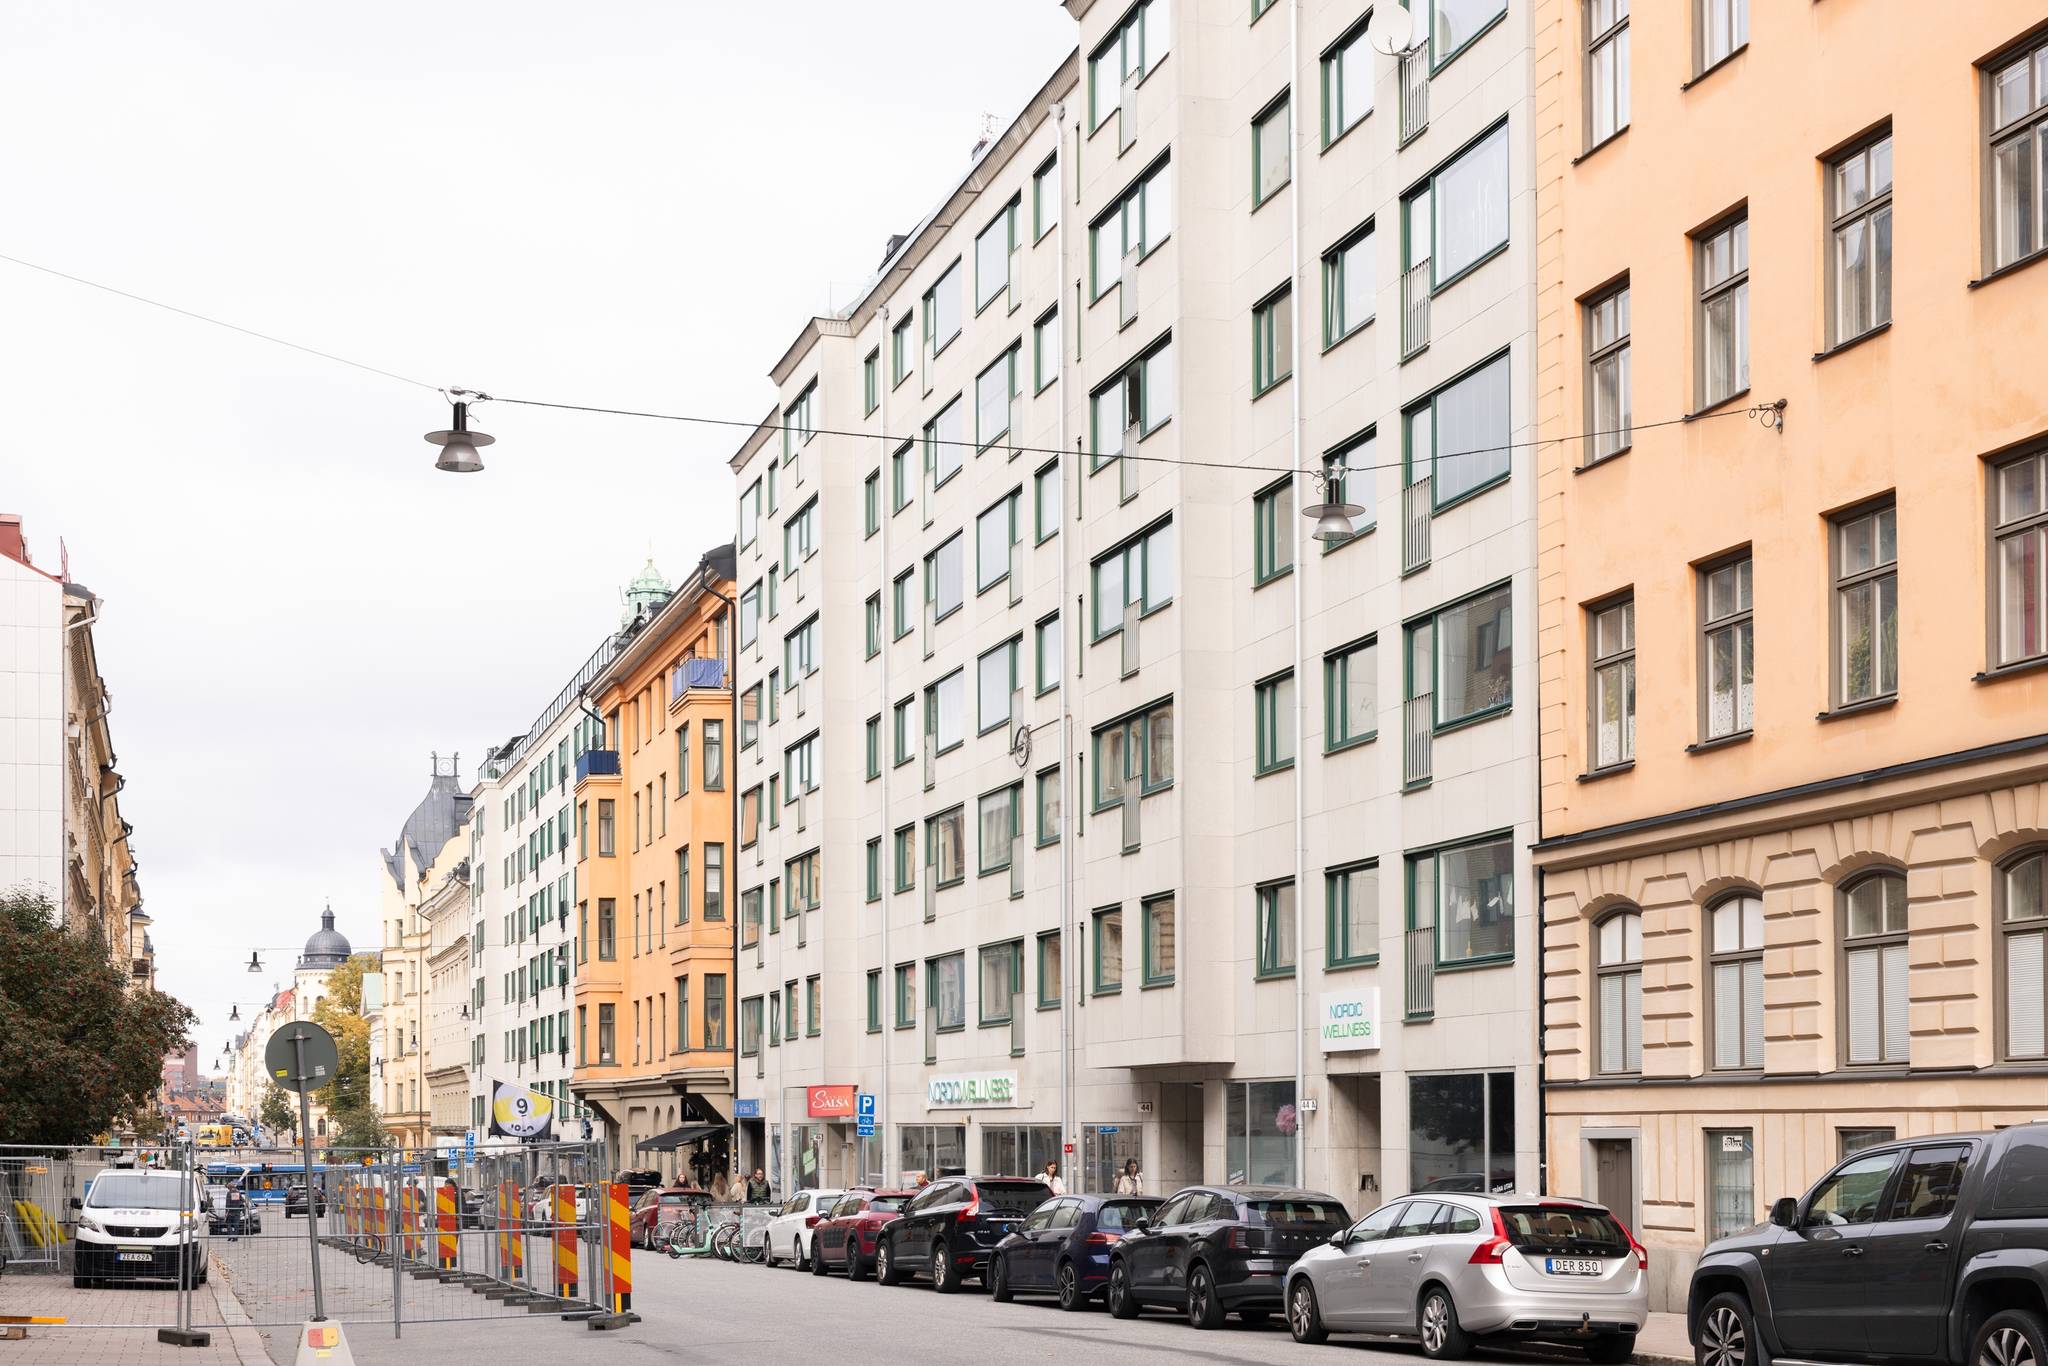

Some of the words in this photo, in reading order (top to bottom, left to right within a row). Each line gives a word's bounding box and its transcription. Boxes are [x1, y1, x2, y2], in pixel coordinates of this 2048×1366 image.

[1329, 1002, 1363, 1019] NORDIC
[1322, 1021, 1371, 1039] WELLNESS
[516, 1098, 528, 1115] 9
[862, 1096, 873, 1114] P
[1140, 1104, 1150, 1112] 44
[1555, 1260, 1575, 1271] DER
[1578, 1261, 1598, 1272] 850
